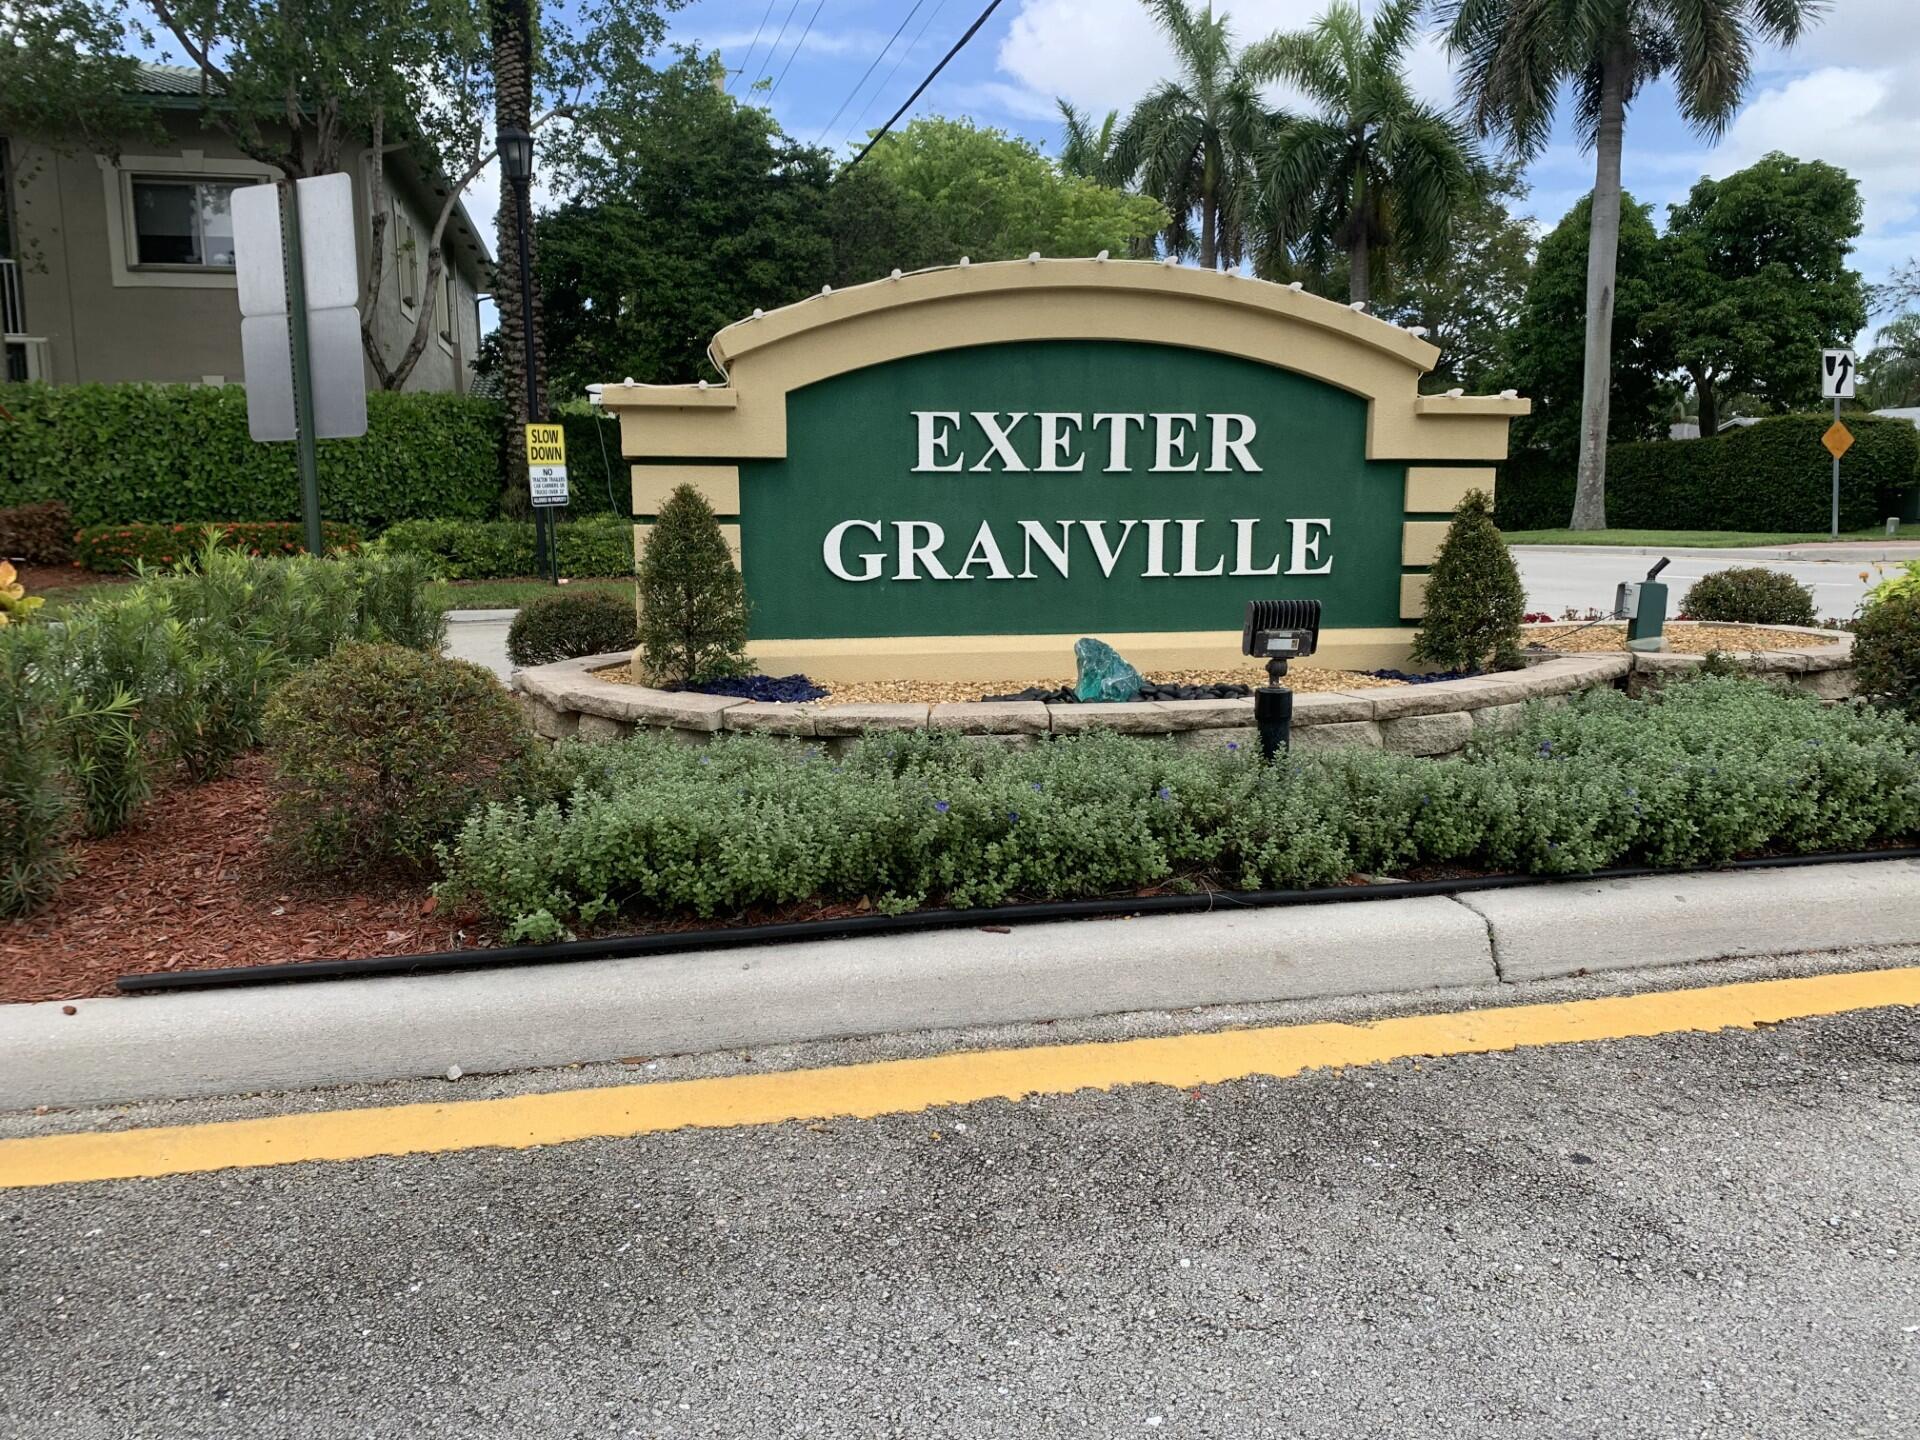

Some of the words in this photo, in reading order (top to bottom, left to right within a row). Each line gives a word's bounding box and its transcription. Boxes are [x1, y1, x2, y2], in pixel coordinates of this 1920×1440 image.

[531, 429, 559, 444] SLOW
[911, 411, 1264, 473] EXETER
[530, 446, 562, 461] DOWN
[542, 468, 553, 476] NO
[824, 518, 1333, 582] GRANVILLE
